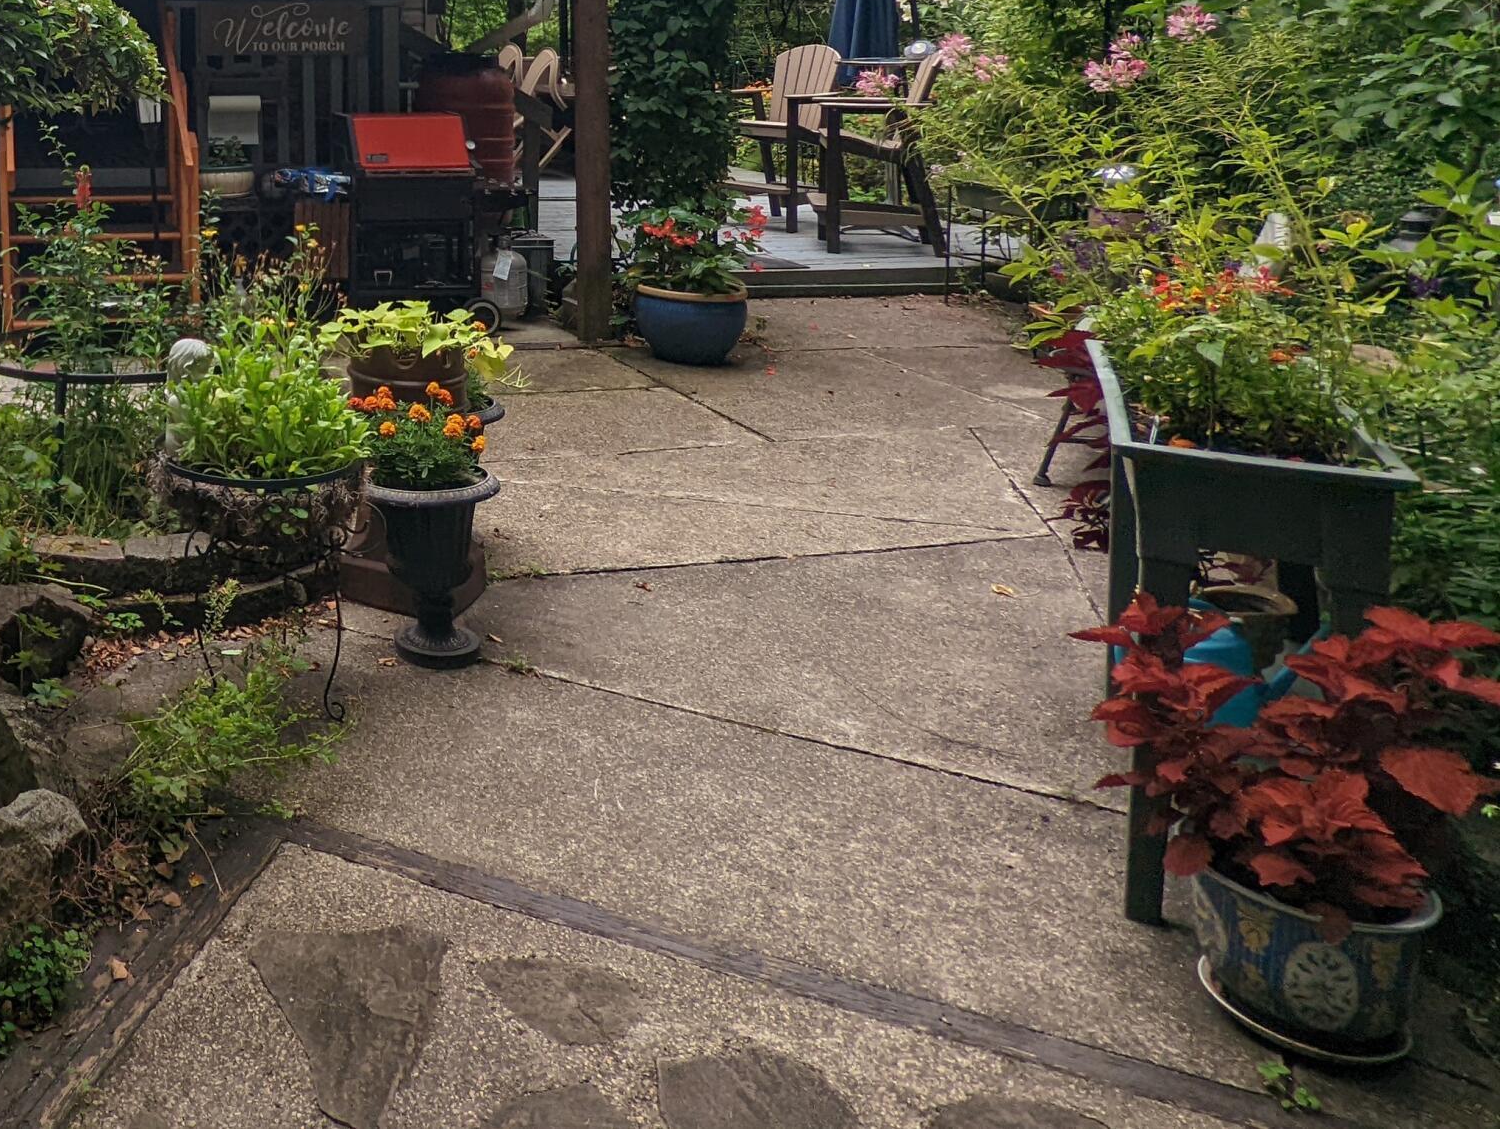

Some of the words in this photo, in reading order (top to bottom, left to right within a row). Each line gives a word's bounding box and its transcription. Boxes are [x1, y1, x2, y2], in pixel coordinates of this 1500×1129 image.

[214, 2, 349, 54] Welcome
[252, 41, 268, 52] TO
[271, 41, 298, 52] OUR
[301, 41, 345, 52] PORCH
